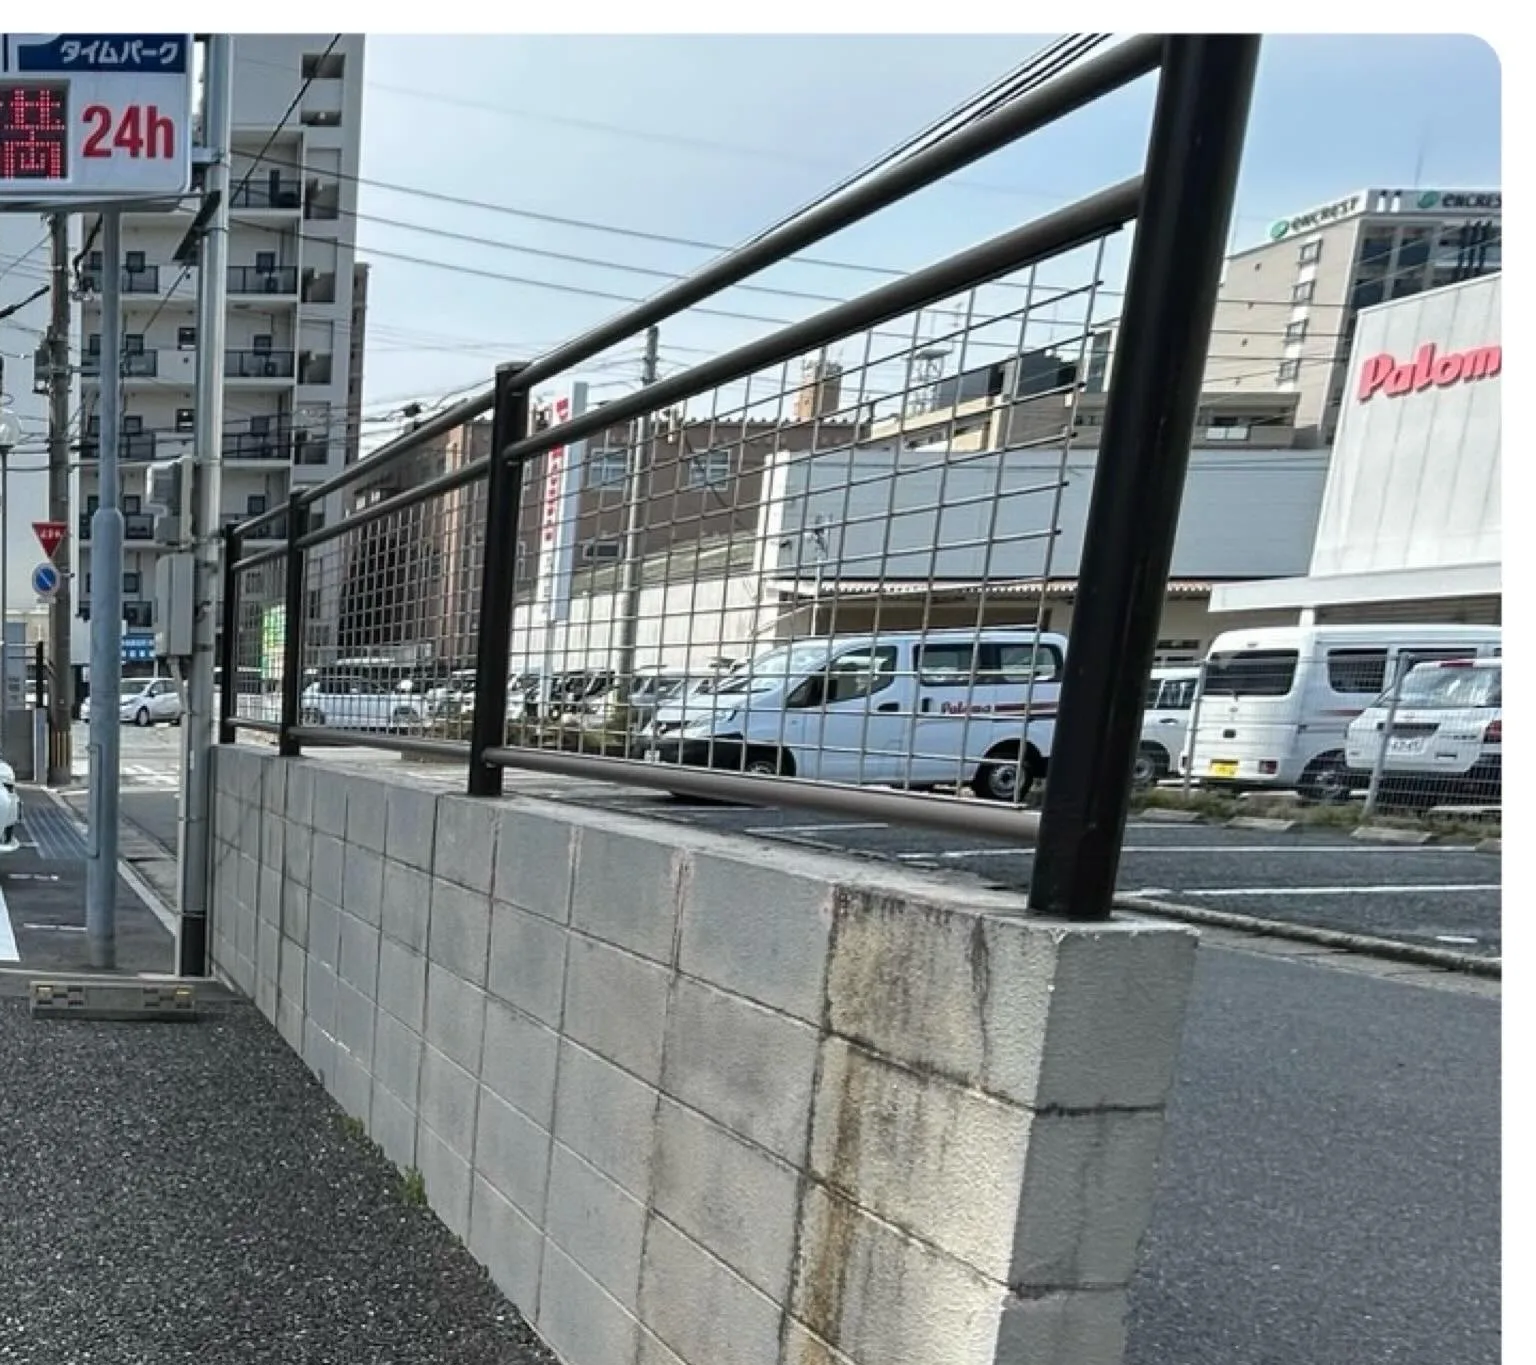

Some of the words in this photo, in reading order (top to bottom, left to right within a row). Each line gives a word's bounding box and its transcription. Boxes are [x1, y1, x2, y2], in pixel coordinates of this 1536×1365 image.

[60, 40, 179, 64] タイムパーク
[82, 105, 175, 160] 24h
[1358, 342, 1502, 405] Palom
